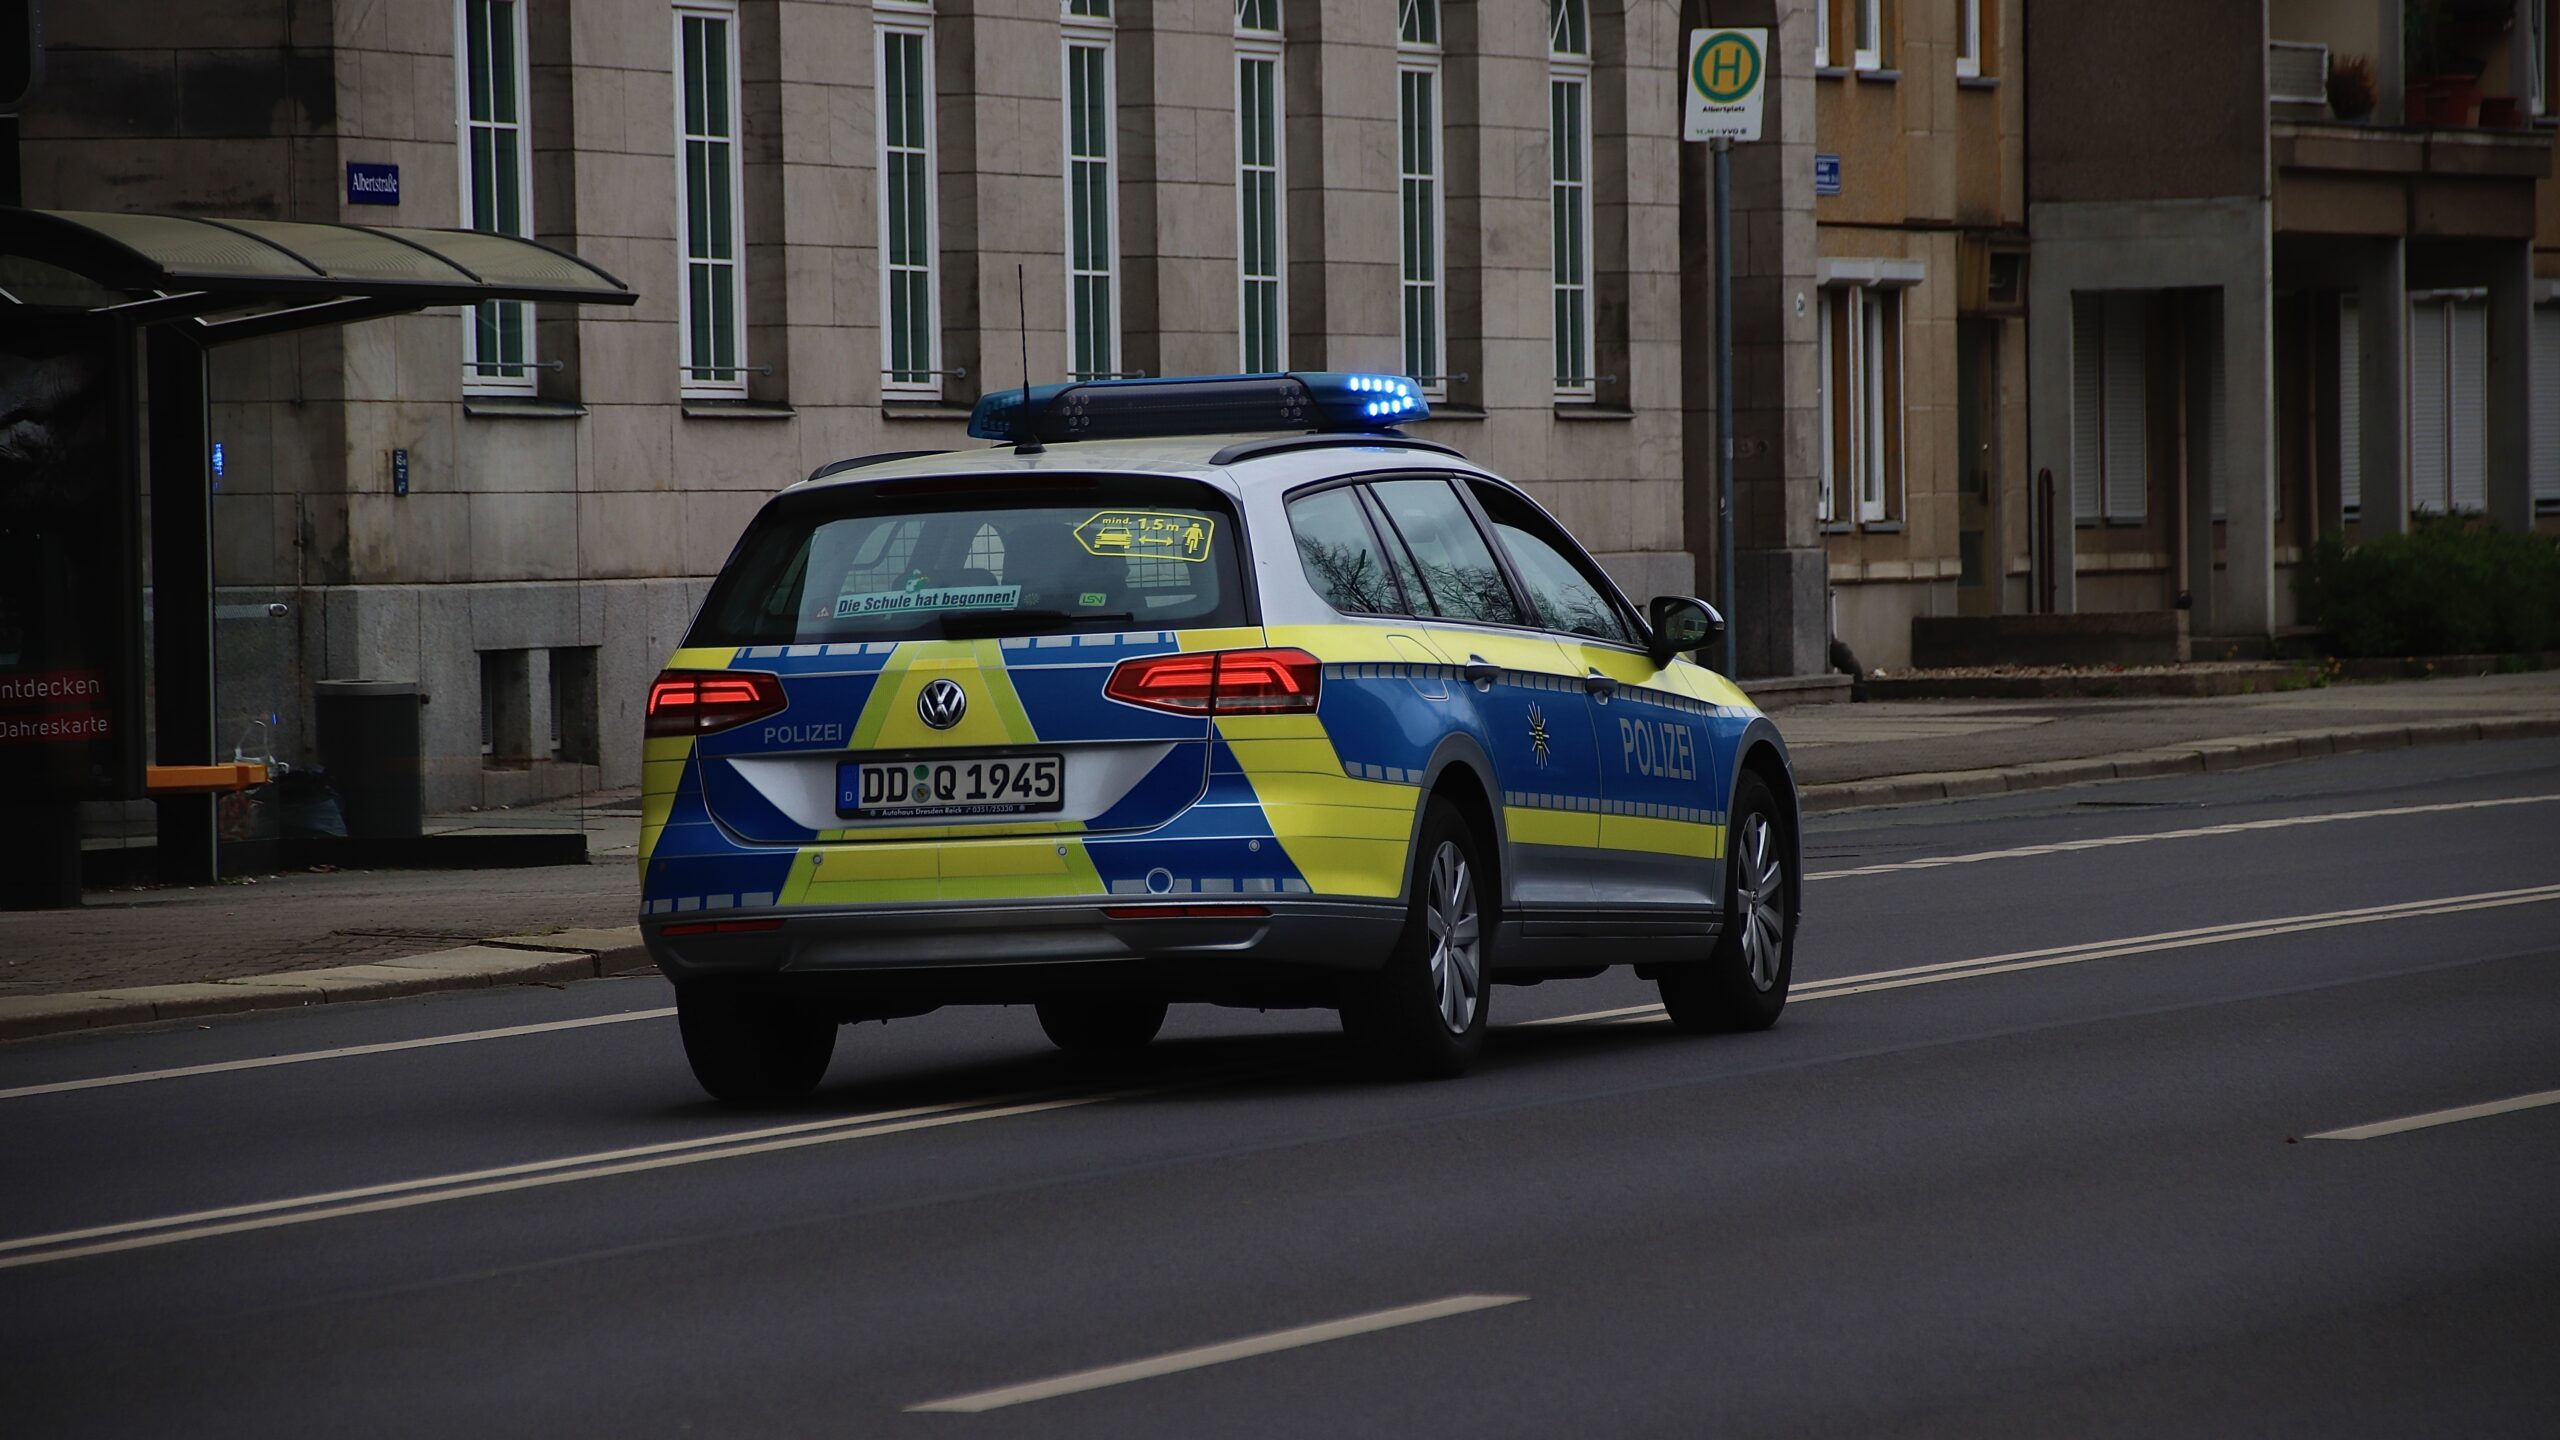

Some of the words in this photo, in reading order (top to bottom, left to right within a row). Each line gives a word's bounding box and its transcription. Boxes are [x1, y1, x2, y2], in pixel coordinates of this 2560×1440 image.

[1713, 48, 1742, 86] H
[1703, 105, 1745, 114] Albertplatz
[352, 172, 397, 192] Albertstraße
[1102, 517, 1132, 525] mind.
[1138, 518, 1164, 531] 1,5
[1166, 524, 1180, 532] m
[838, 599, 860, 613] Die
[864, 595, 911, 610] Schule
[915, 592, 938, 606] hat
[942, 590, 1016, 607] begonnen!
[0, 716, 108, 738] Jahreskarte
[764, 723, 843, 744] POLIZEI
[1619, 717, 1696, 781] POLIZEI
[862, 767, 908, 803] DD
[934, 765, 956, 800] Q
[966, 762, 1056, 800] 1945
[845, 791, 853, 802] D
[882, 808, 914, 816] Autohaus
[915, 807, 943, 815] Dresden
